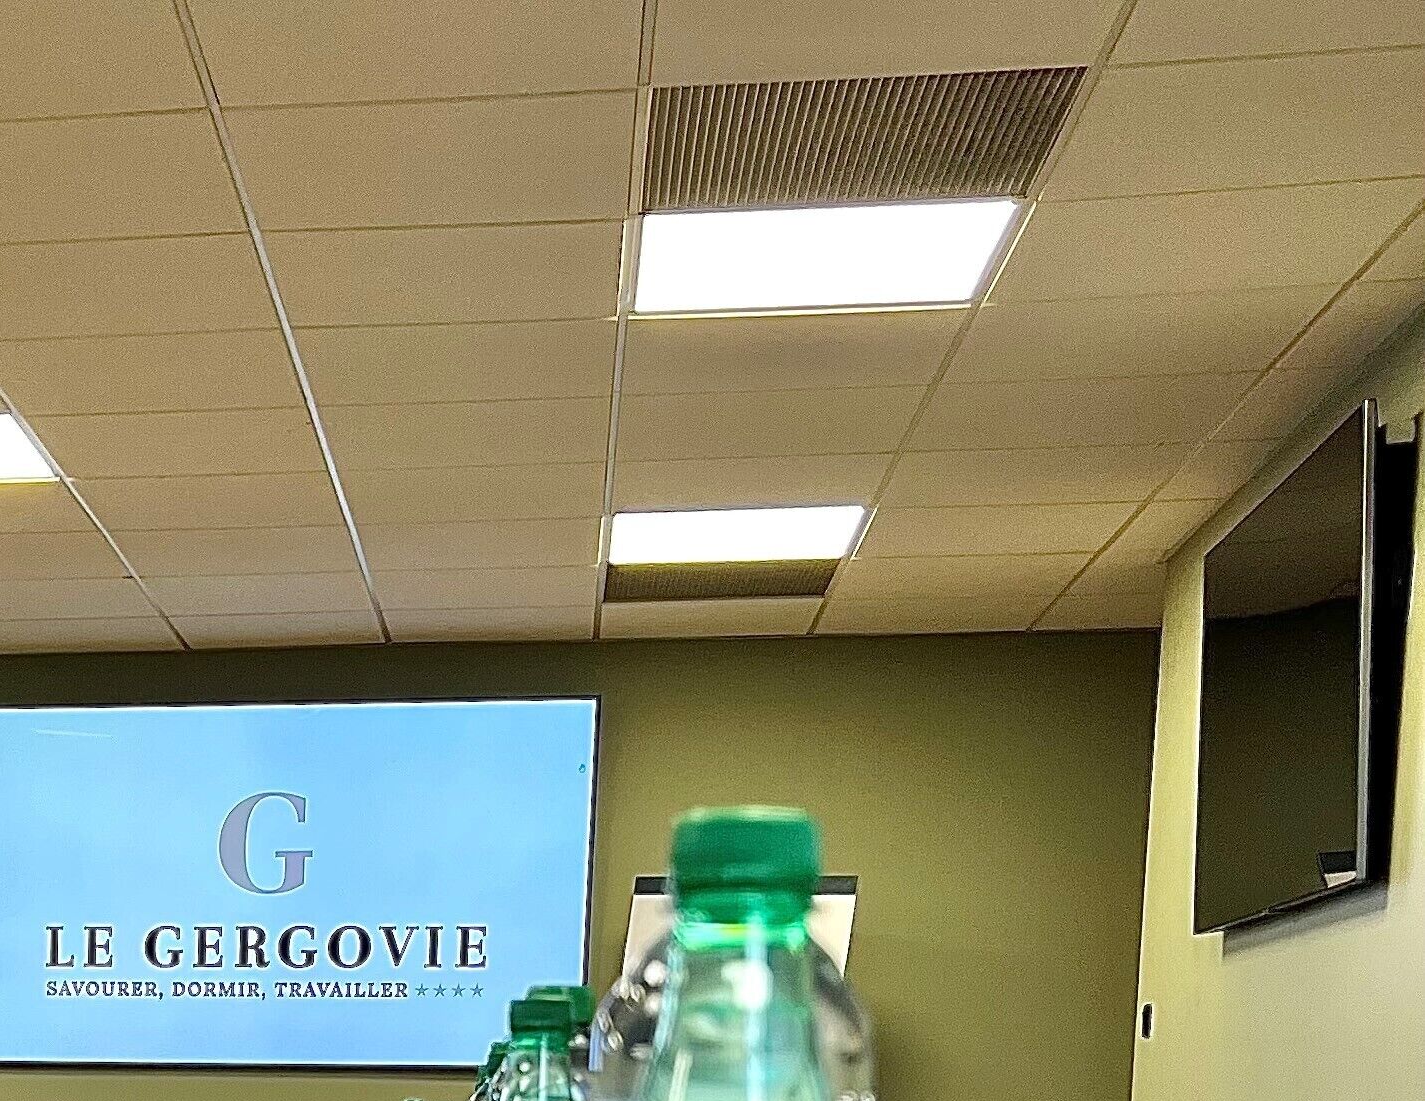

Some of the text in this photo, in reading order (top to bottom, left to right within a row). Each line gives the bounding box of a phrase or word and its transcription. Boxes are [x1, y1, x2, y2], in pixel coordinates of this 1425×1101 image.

[218, 791, 314, 895] G
[45, 924, 488, 970] LE GERGOVIE
[46, 981, 408, 1001] SAVOURER, DORMIR, TRAVAILLER
